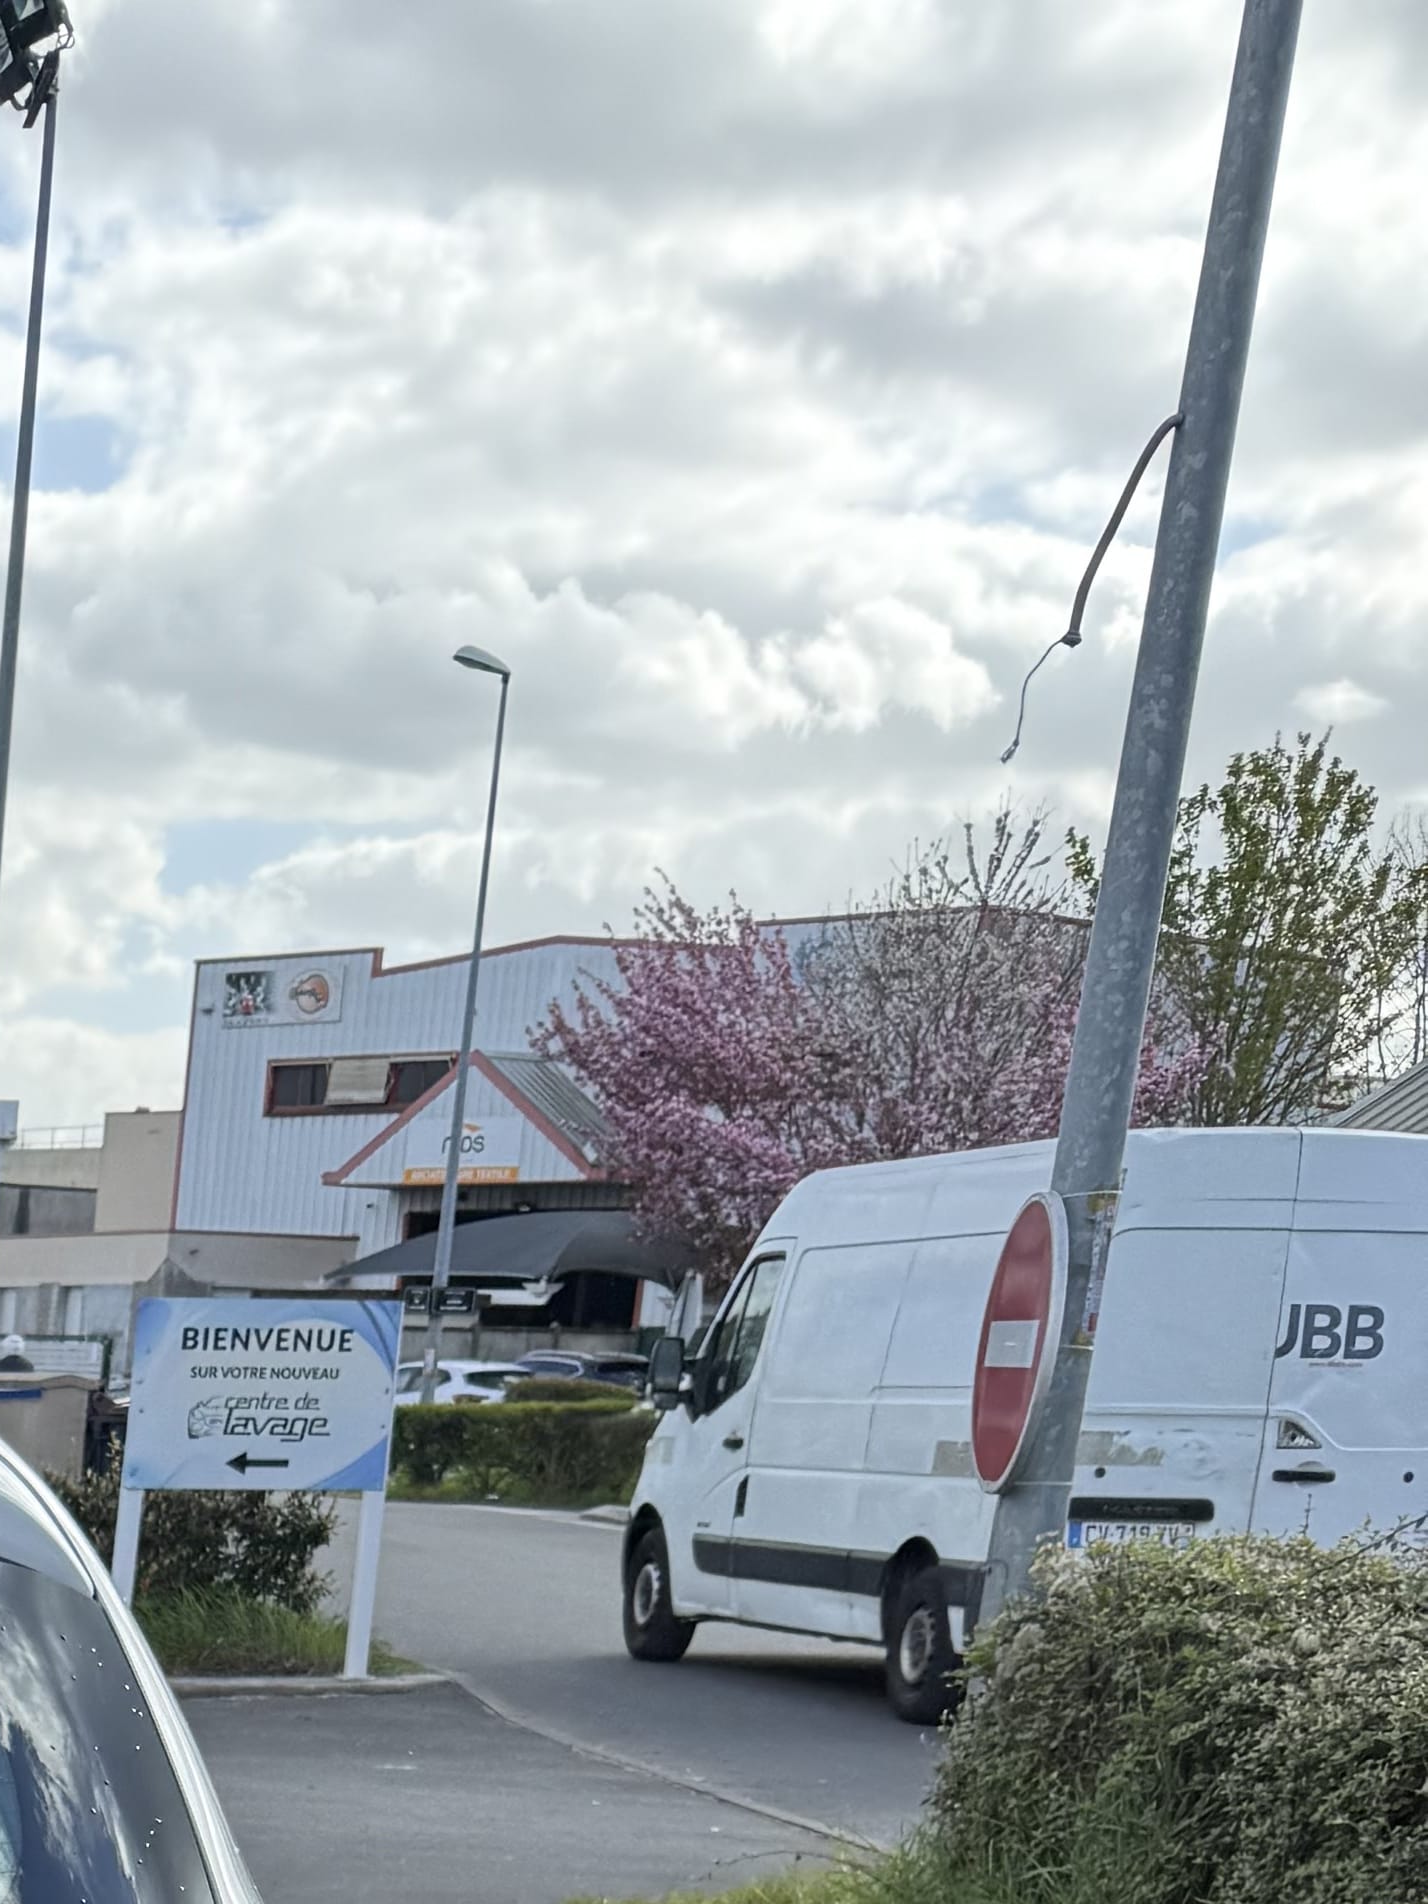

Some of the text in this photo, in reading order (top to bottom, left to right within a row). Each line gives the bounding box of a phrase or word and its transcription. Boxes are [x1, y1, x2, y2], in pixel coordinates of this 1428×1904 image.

[181, 1327, 354, 1352] BIENVENUE
[190, 1366, 340, 1380] SUR VOTRE NOUVEAU
[224, 1391, 321, 1411] centre de
[223, 1406, 331, 1442] lavage
